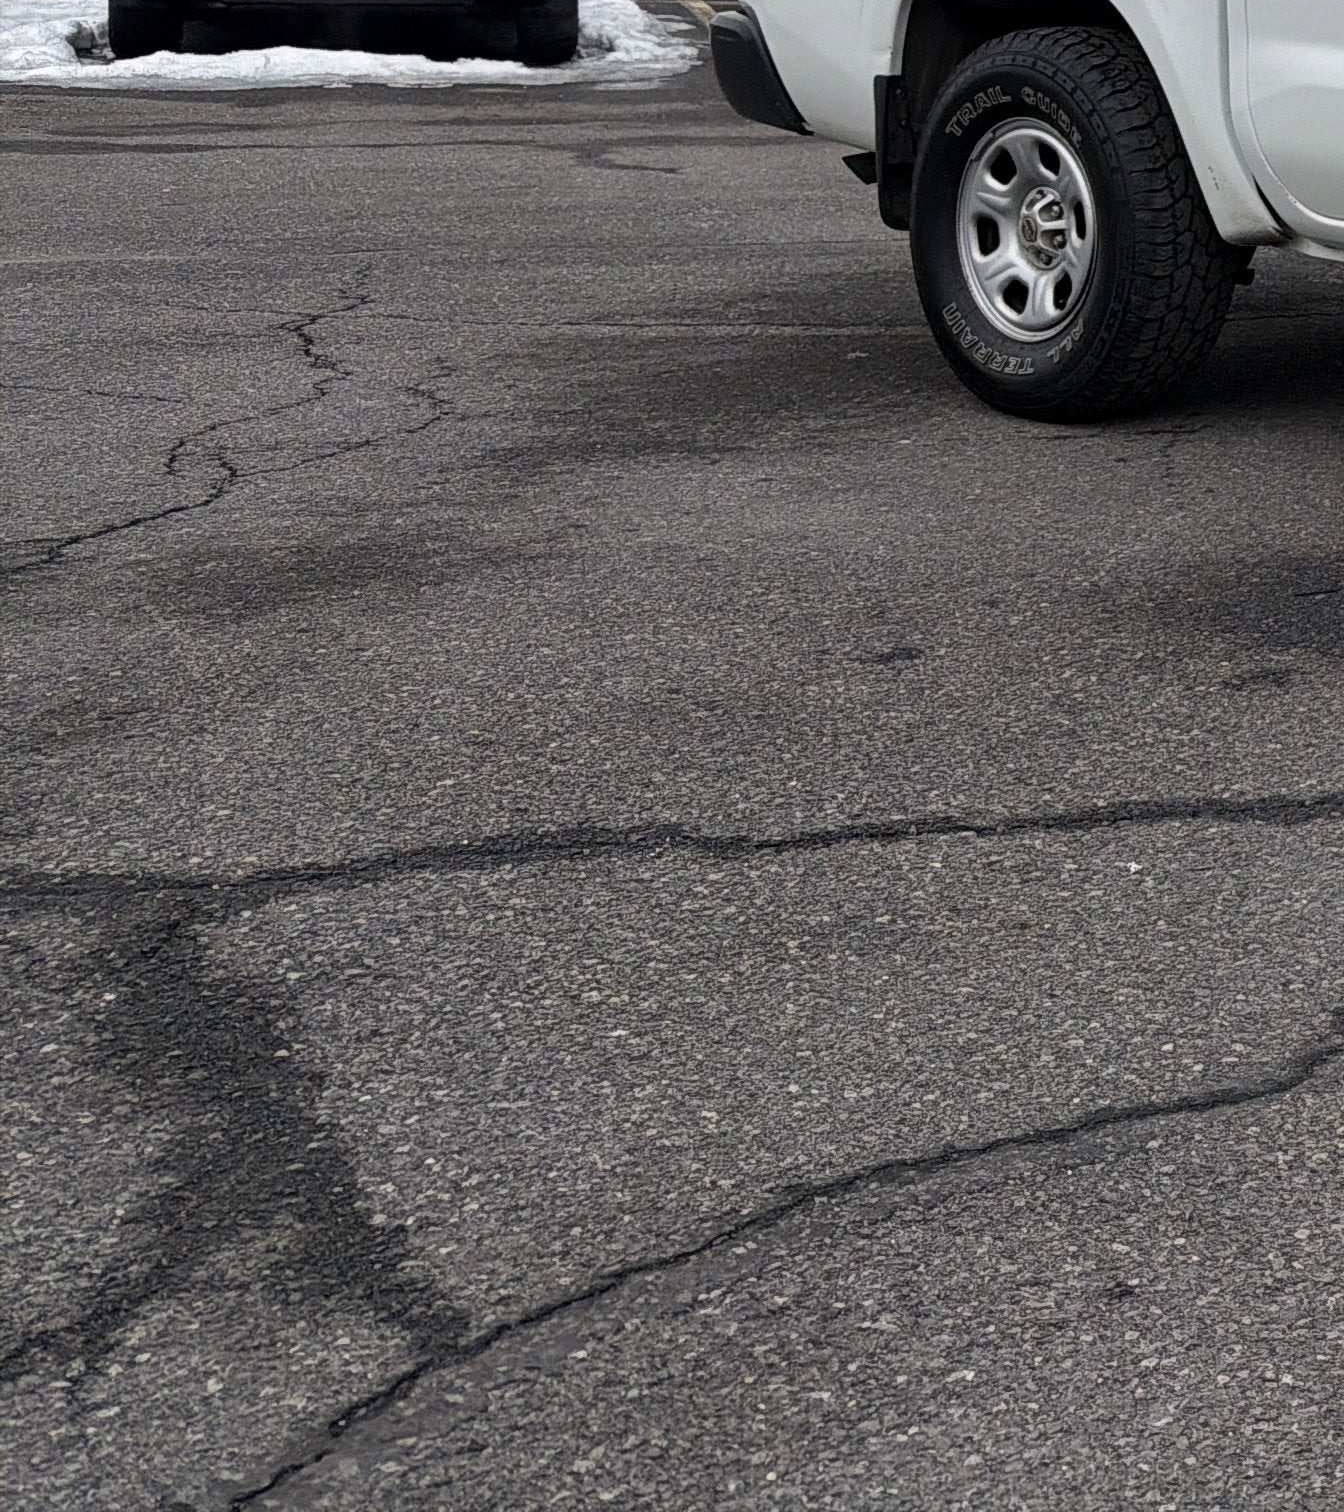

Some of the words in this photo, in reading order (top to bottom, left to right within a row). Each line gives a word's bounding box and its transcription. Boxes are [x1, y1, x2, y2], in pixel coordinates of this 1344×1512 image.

[945, 85, 1012, 137] TRAIL
[1021, 86, 1082, 149] GUIDE
[942, 302, 1034, 375] TERRAIN
[1047, 318, 1084, 363] ALL
